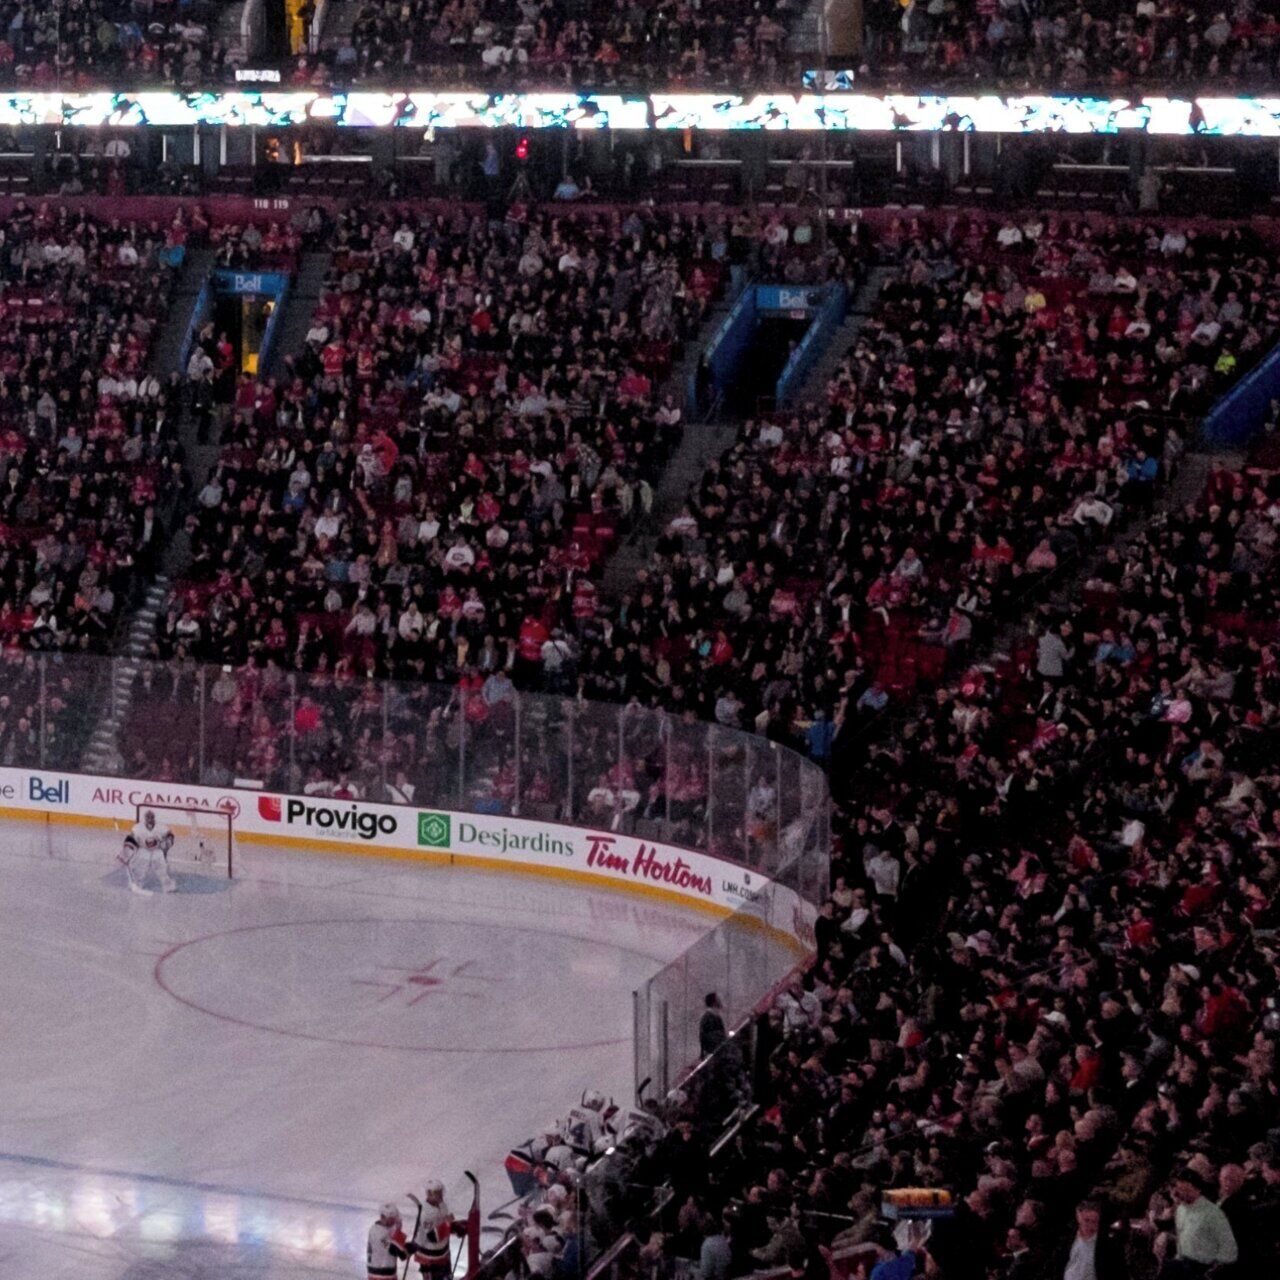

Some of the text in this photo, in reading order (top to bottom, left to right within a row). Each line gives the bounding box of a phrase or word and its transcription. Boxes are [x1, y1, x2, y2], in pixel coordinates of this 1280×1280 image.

[235, 274, 262, 292] Bell
[29, 775, 70, 805] Bell
[92, 787, 210, 807] AIR CANADA
[287, 798, 397, 840] Provigo
[458, 822, 575, 858] Desjardins
[586, 834, 713, 897] Tim Hortons
